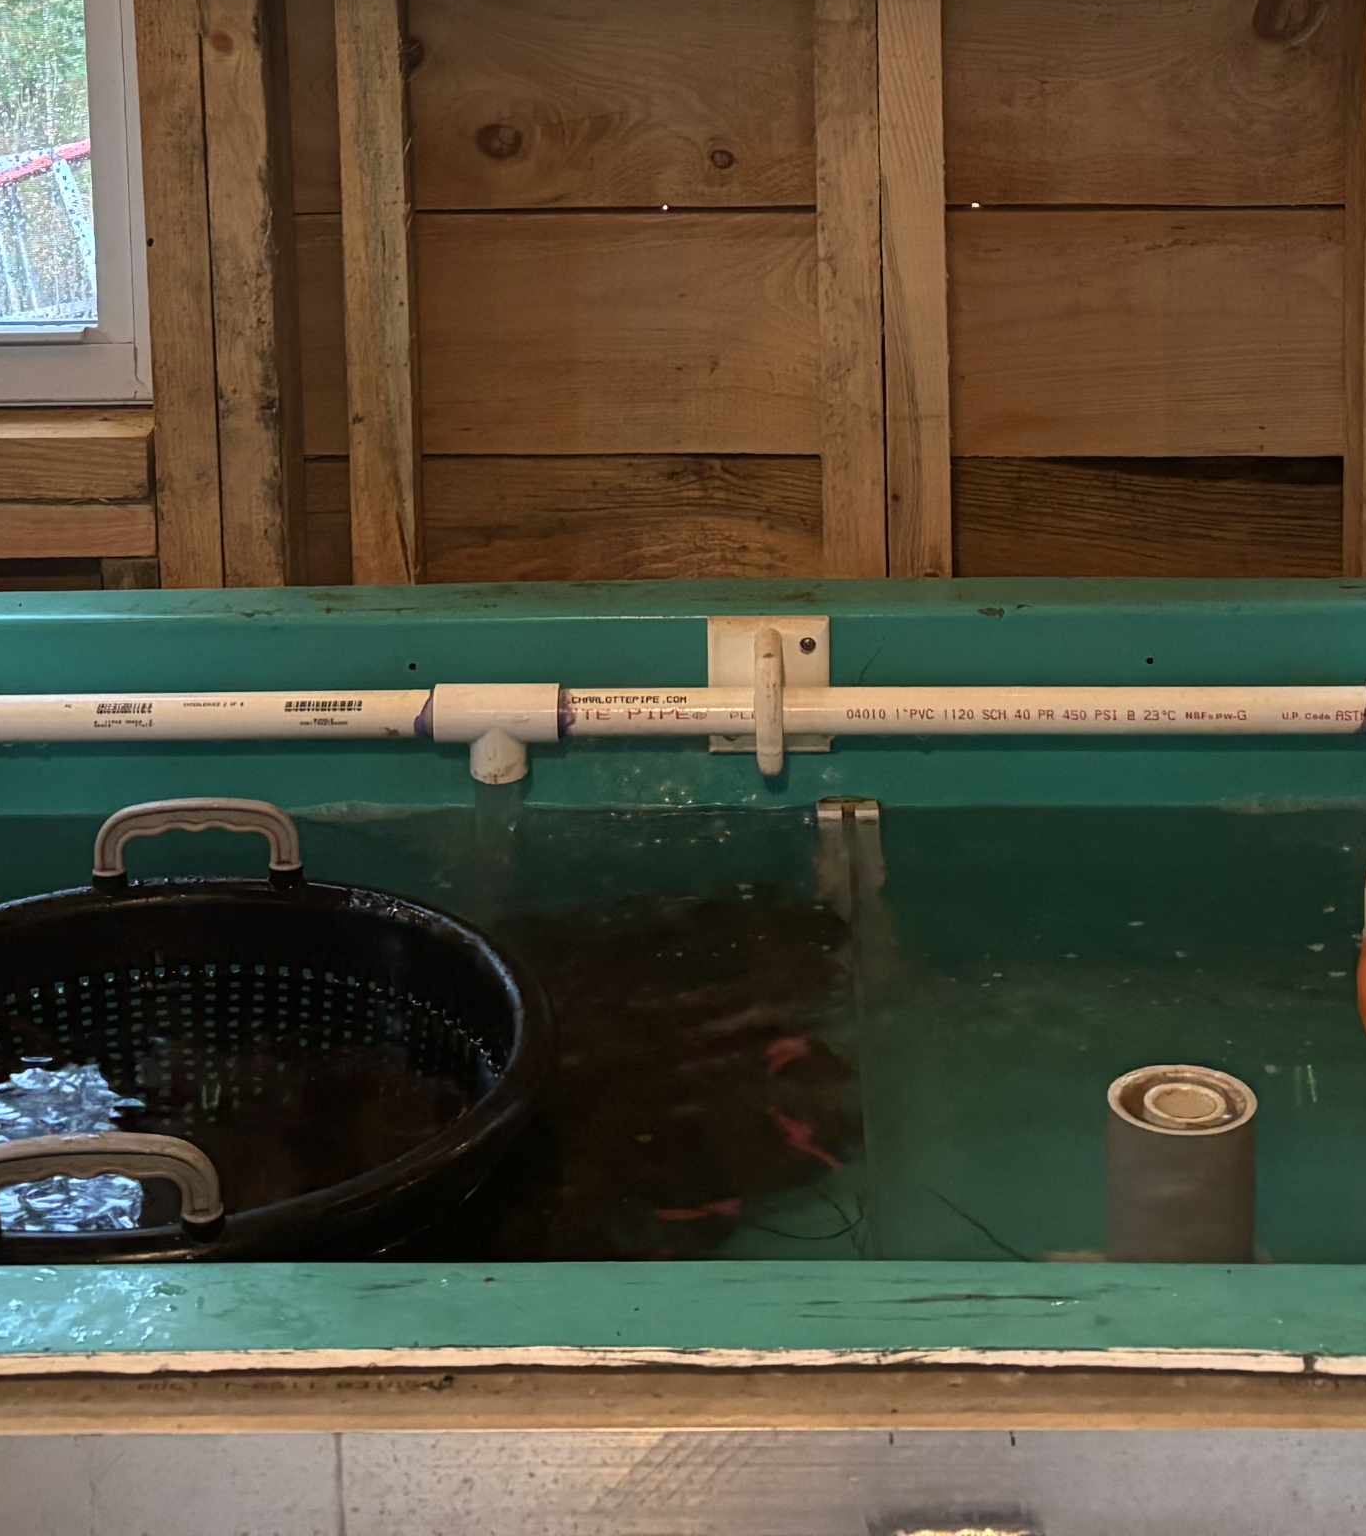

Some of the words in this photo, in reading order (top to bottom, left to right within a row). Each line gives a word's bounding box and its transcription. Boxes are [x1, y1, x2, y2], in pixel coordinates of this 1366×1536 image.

[845, 708, 886, 721] 04010
[943, 708, 975, 721] 1120
[982, 708, 1008, 721] SCH
[1014, 708, 1031, 721] 40
[1037, 708, 1055, 721] PR
[1062, 708, 1087, 721] 450
[1094, 709, 1118, 721] PSI
[1143, 709, 1176, 721] 23°C
